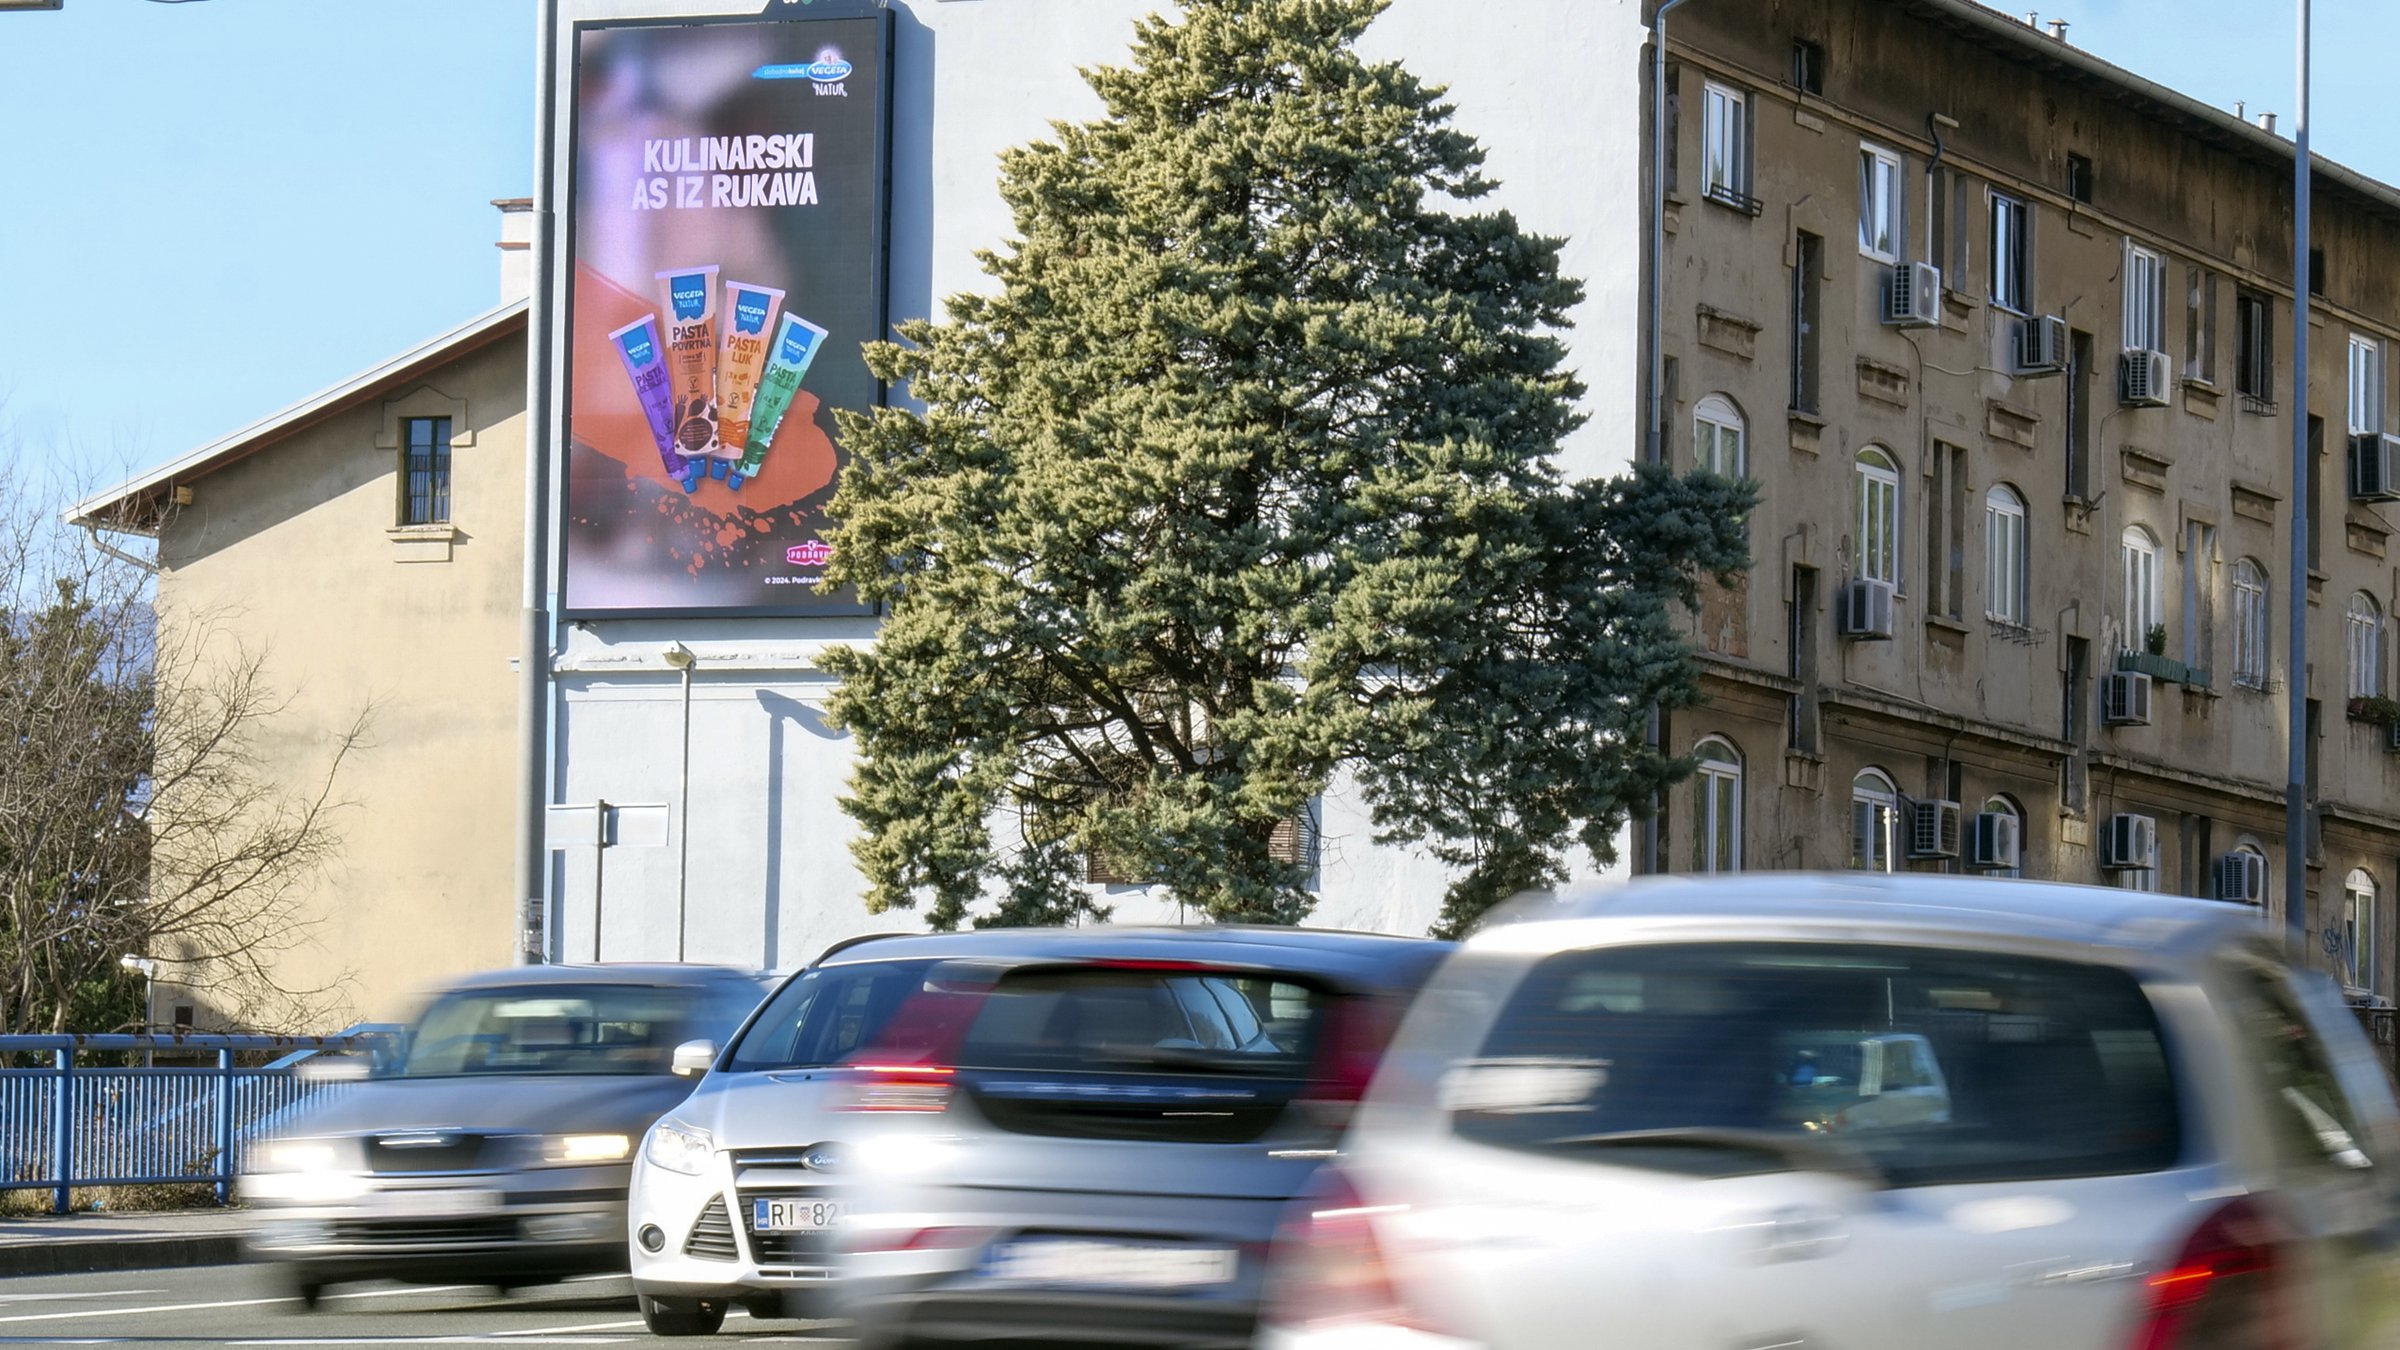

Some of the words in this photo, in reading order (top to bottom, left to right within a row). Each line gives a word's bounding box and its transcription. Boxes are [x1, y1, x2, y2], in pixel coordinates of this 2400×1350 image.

[811, 66, 848, 75] VEGETA
[812, 82, 848, 97] NATUR
[644, 133, 814, 173] KULINARSKI
[632, 177, 669, 211] AS
[675, 175, 704, 209] IZ
[711, 171, 818, 208] RUKAVA
[673, 290, 705, 300] VEGETA
[737, 304, 766, 316] VEGETA
[673, 323, 709, 341] PASTA
[671, 338, 712, 352] POVRTNA
[727, 335, 761, 354] PASTA
[731, 351, 754, 366] LUK
[635, 365, 666, 388] PASTA
[769, 362, 797, 385] PASTA
[790, 551, 830, 559] PODRAVK
[771, 576, 791, 585] 2024.
[792, 576, 821, 584] Podravk
[771, 1203, 794, 1227] RI
